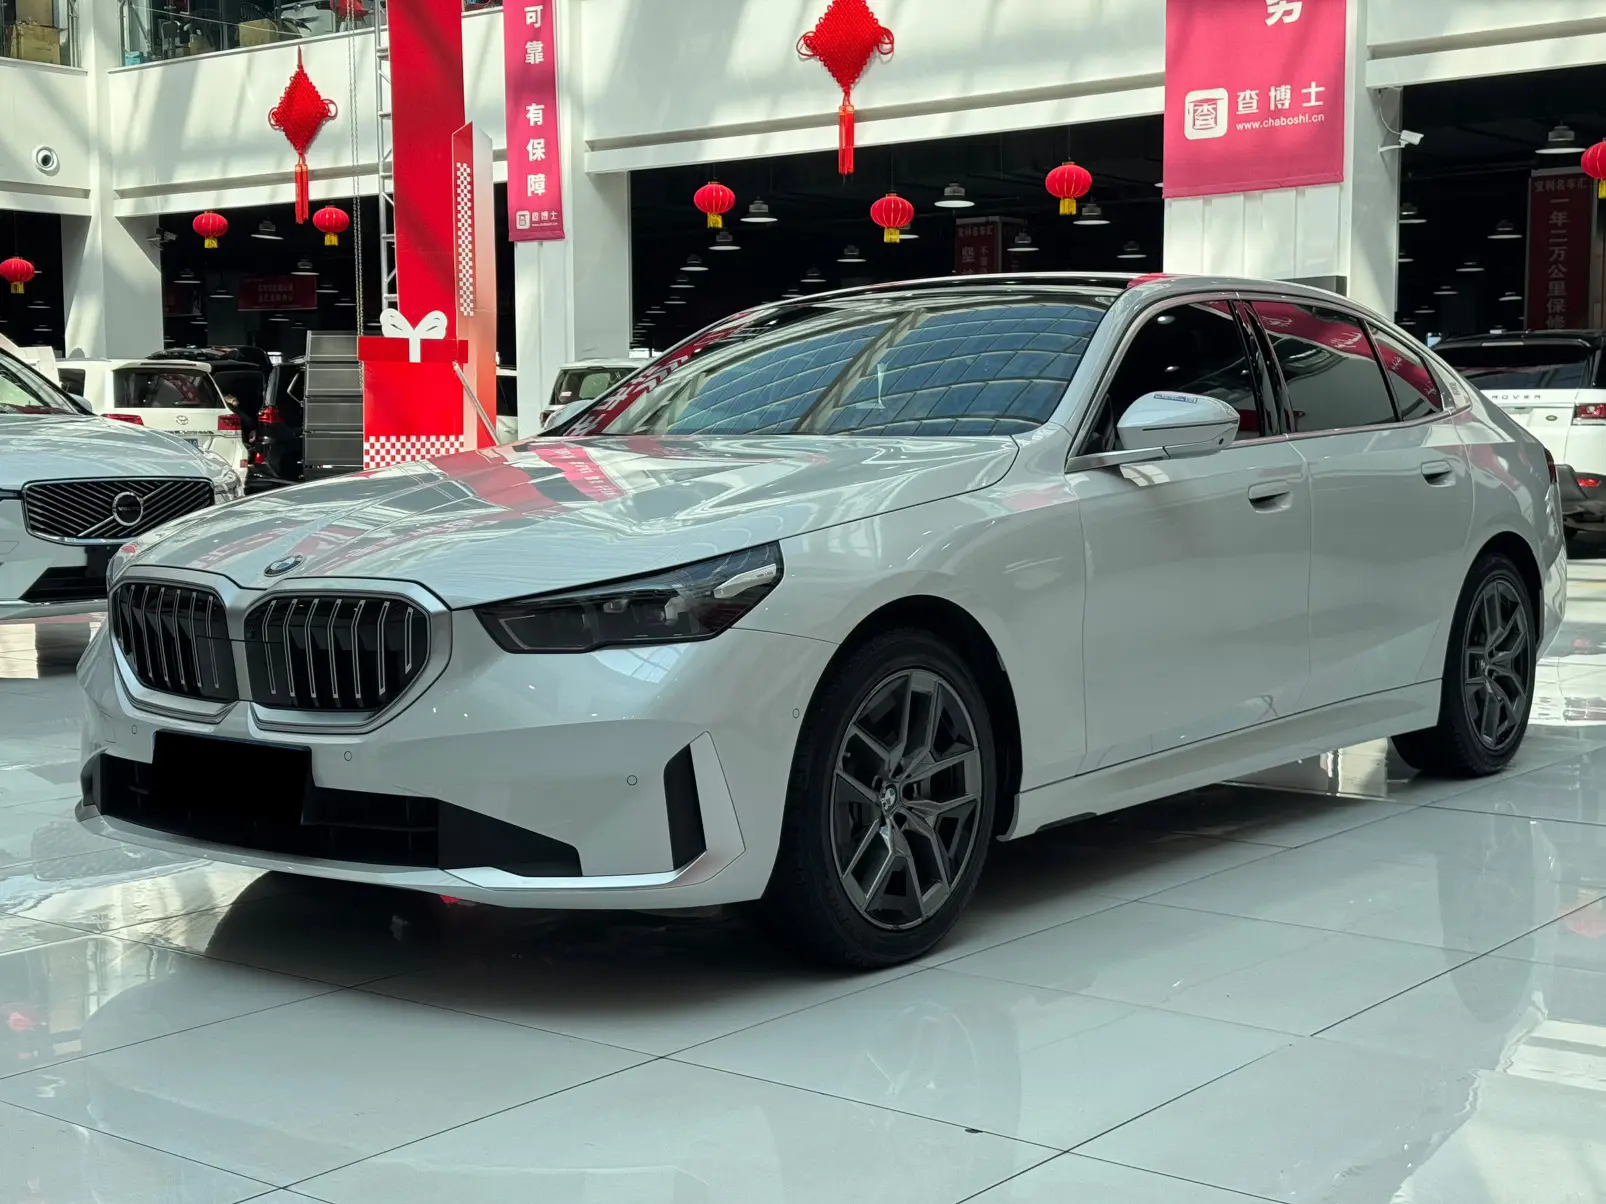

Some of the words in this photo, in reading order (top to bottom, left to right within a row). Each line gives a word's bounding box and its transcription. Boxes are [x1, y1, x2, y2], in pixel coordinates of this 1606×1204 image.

[524, 5, 544, 64] 可靠
[1235, 112, 1326, 131] www.chaboshi.cn
[1236, 81, 1326, 115] 查博士
[525, 102, 546, 197] 有保障
[1545, 197, 1570, 329] 一年二万公里保修
